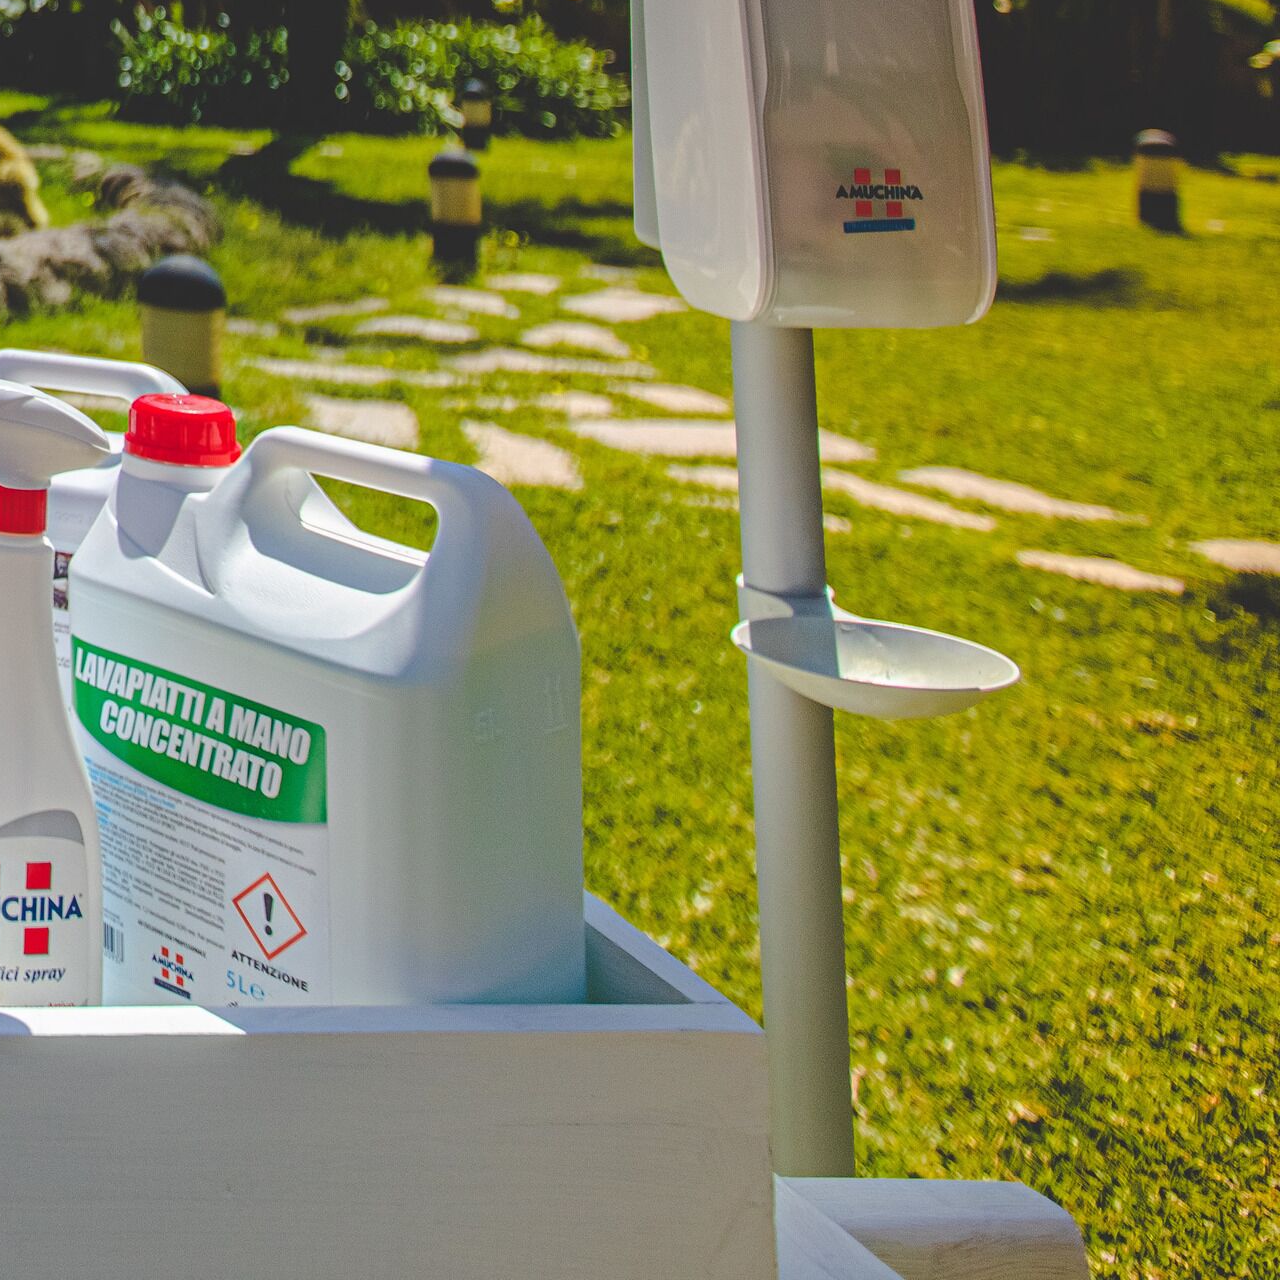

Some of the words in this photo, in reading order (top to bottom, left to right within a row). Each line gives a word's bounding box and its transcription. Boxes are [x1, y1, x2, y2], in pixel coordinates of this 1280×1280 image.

[836, 184, 923, 200] AMUCHINA
[74, 647, 206, 726] LAVAPIATTI
[205, 696, 226, 735] A
[228, 704, 312, 766] MANO
[100, 699, 283, 799] CONCENTRATO
[23, 967, 67, 983] spray
[151, 953, 194, 982] AMUCHINA
[231, 949, 310, 993] ATTENZIONE
